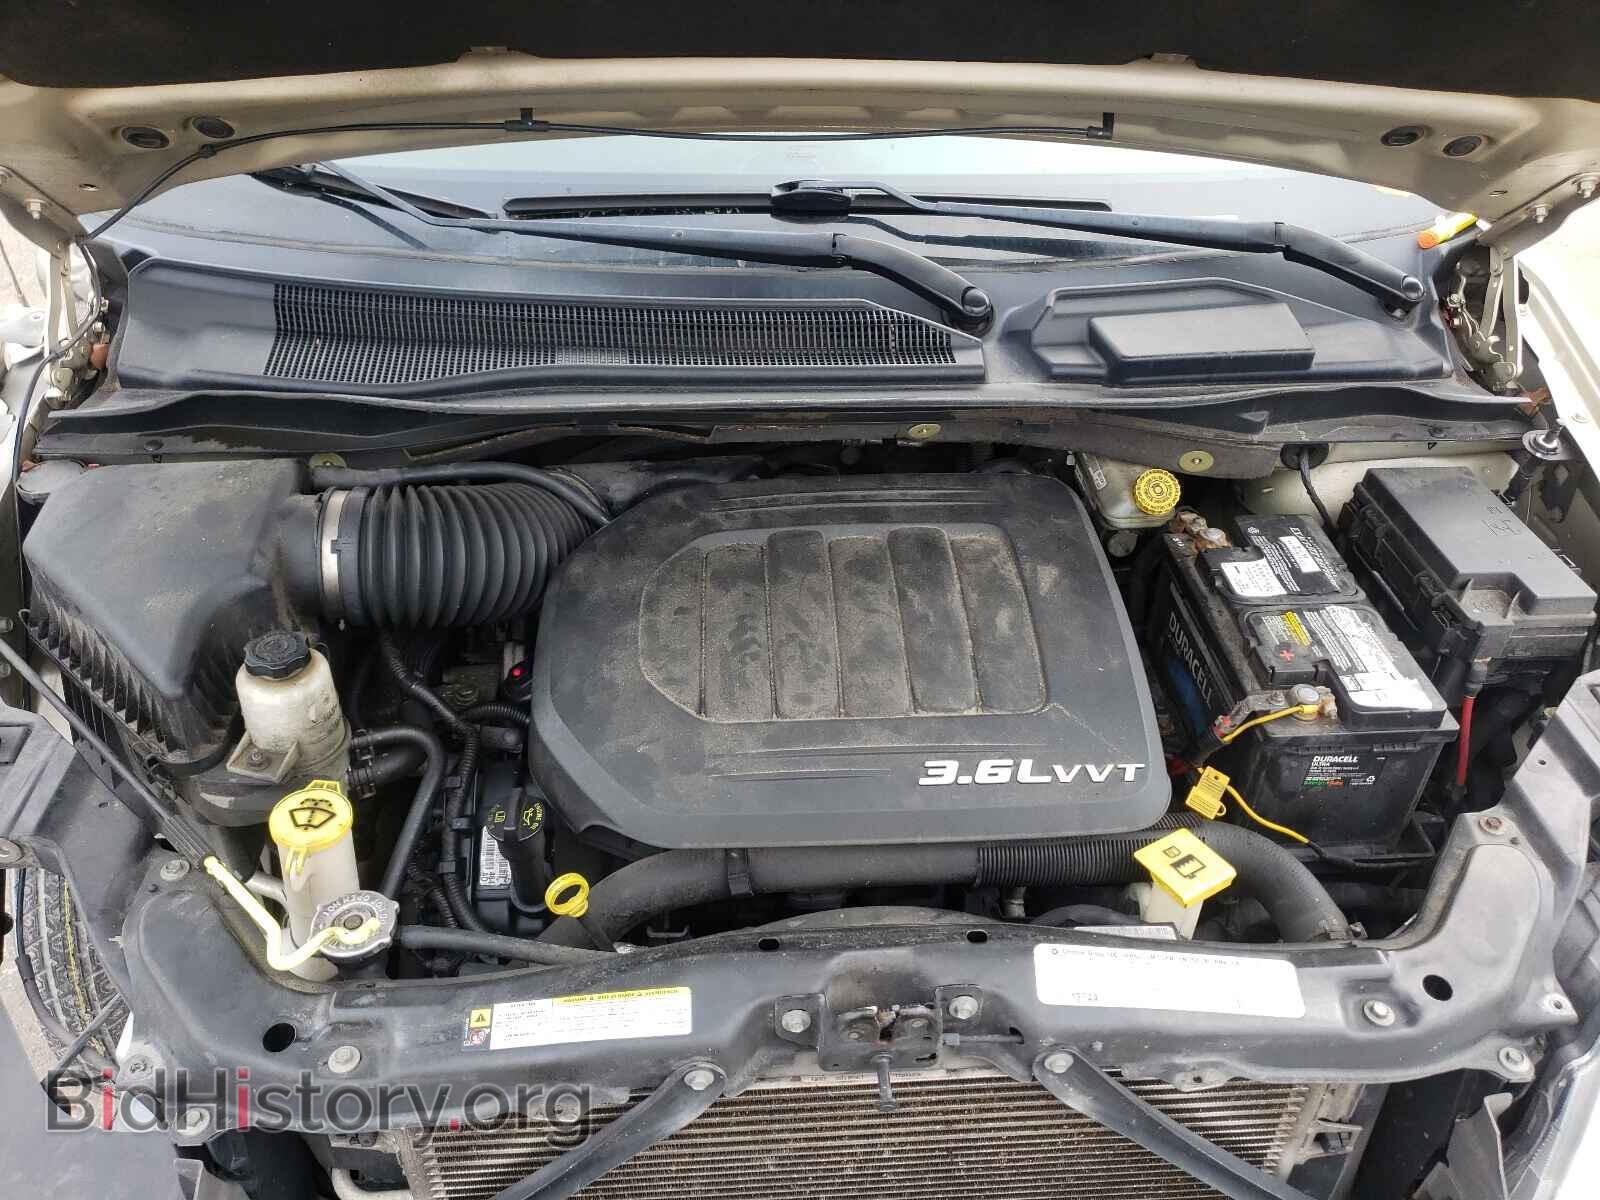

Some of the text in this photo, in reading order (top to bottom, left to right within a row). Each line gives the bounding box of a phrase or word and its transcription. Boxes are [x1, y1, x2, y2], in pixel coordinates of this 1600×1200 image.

[1169, 611, 1212, 710] DURACELL
[918, 758, 1146, 786] 3.6L VVT
[1312, 755, 1359, 763] DURACELL
